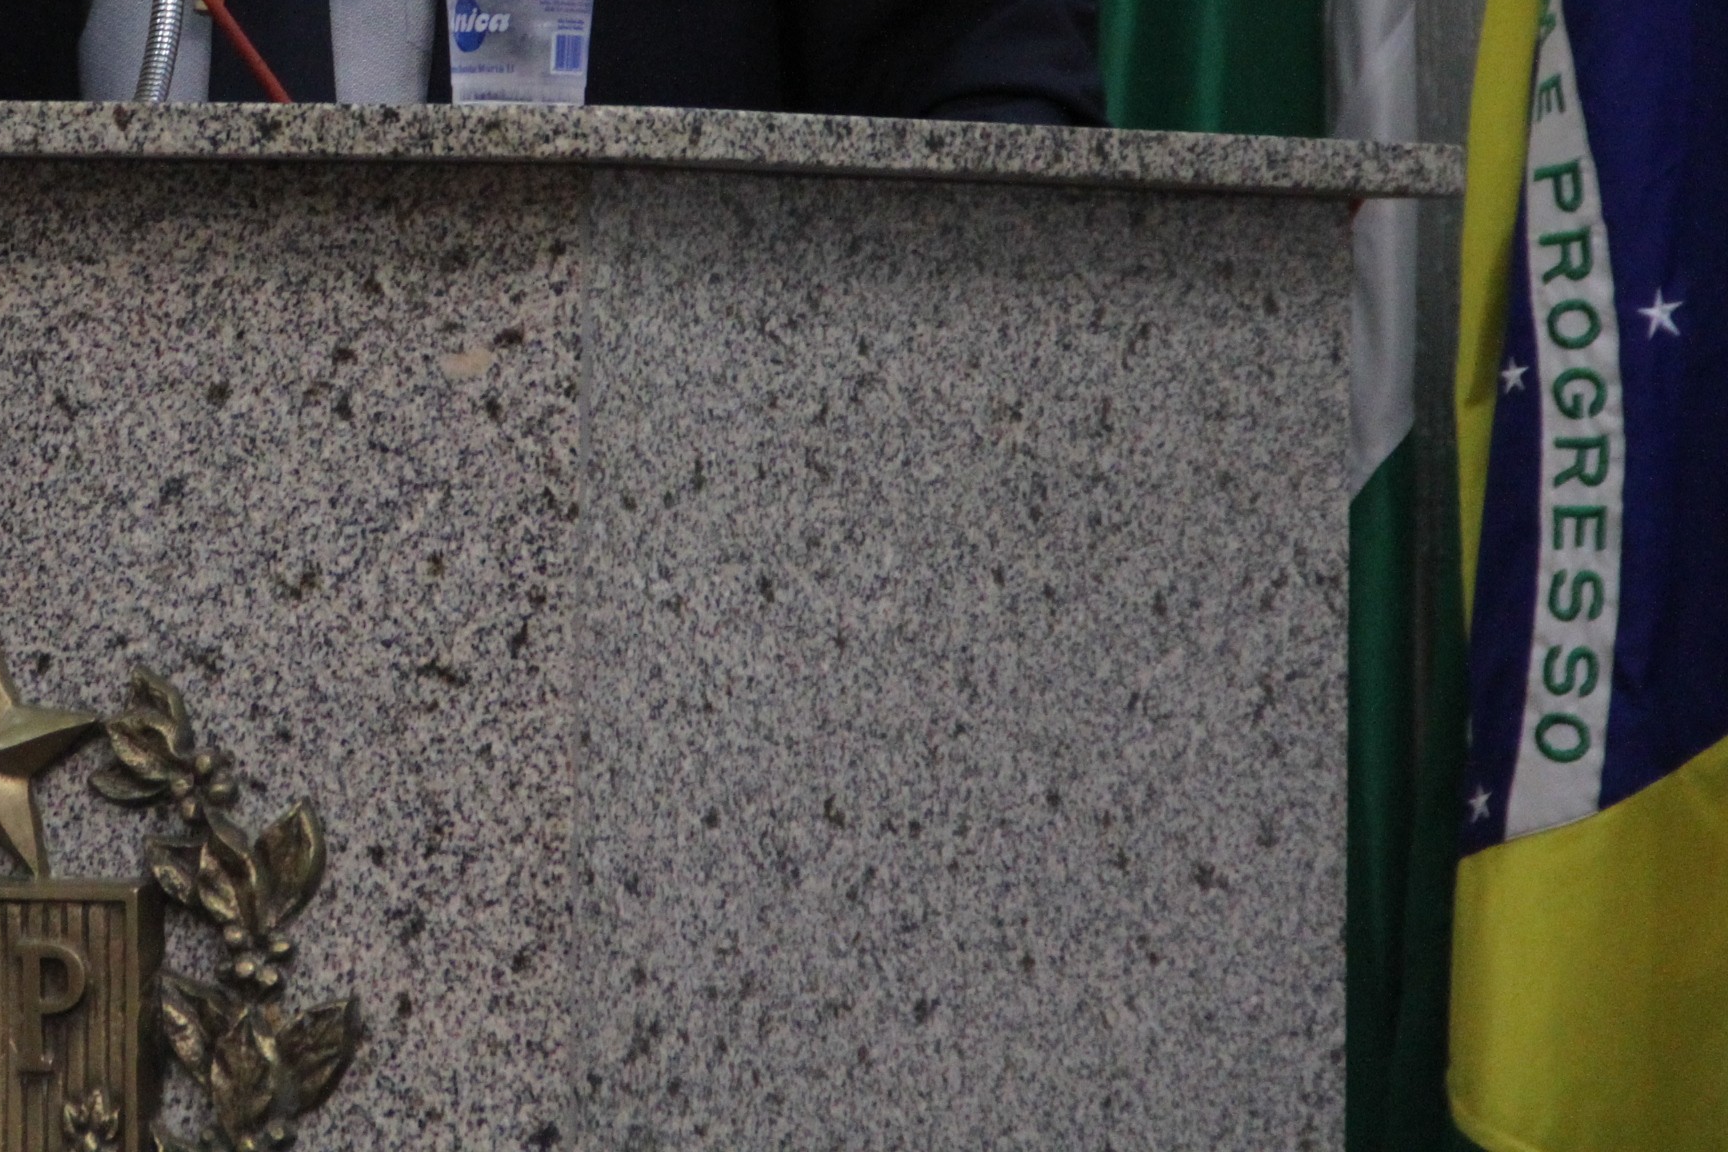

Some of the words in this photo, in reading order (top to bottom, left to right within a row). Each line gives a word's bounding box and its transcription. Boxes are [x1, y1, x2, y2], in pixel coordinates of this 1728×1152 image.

[1536, 74, 1567, 123] E
[1533, 157, 1610, 764] PROGRESSO
[13, 939, 87, 1073] P
